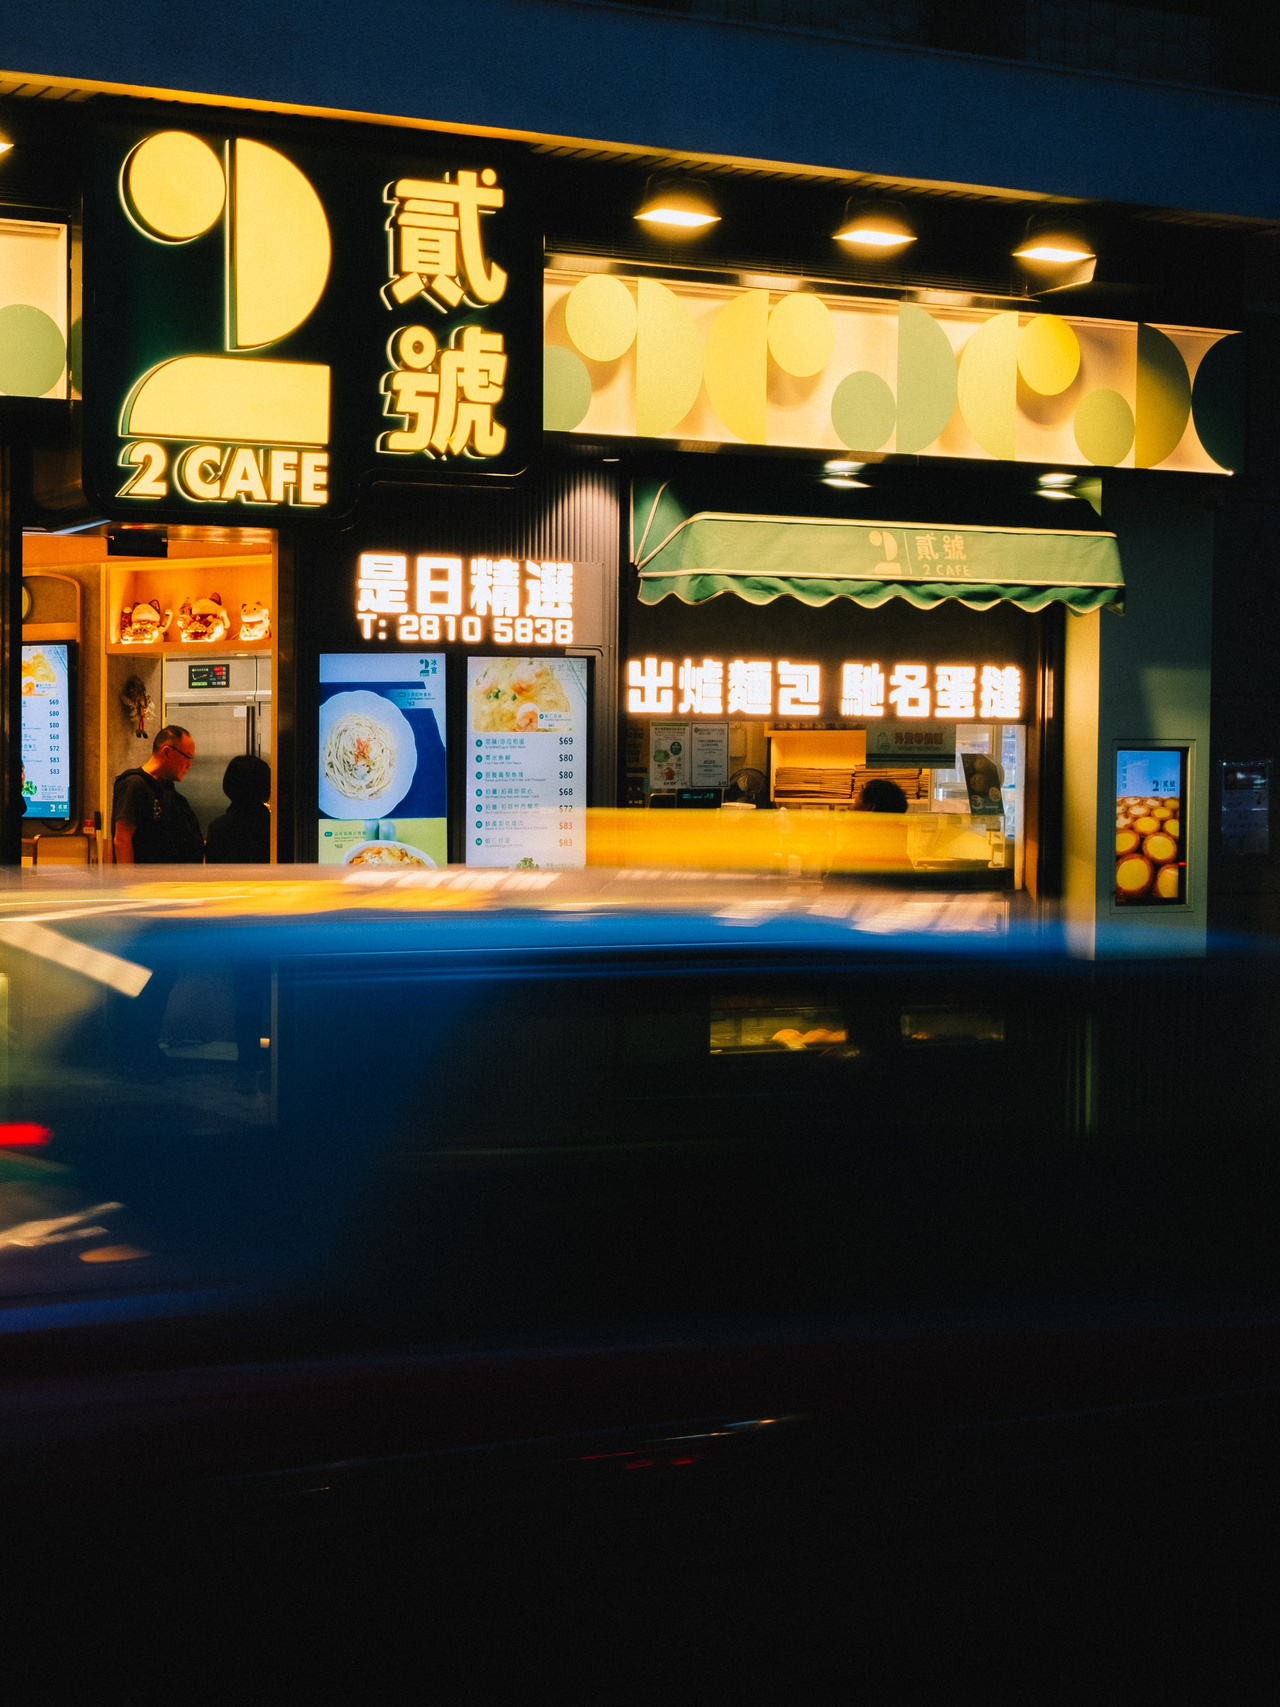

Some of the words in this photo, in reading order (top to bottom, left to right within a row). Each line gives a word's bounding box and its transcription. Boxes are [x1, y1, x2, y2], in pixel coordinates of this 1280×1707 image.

[119, 130, 332, 447] 2
[382, 167, 508, 458] 貳號
[119, 441, 167, 497] 2
[177, 444, 329, 505] CAFE
[915, 531, 967, 561] 貳號
[922, 563, 931, 576] 2
[935, 564, 970, 577] CAFE
[357, 553, 574, 618] 是日精選
[357, 613, 387, 640] T:
[398, 614, 482, 643] 2810
[493, 617, 574, 644] 5838
[627, 657, 821, 715] 出爐麵包
[840, 662, 1021, 719] 馳名蛋撻
[558, 737, 574, 746] $69
[558, 754, 574, 762] $80
[558, 771, 574, 779] $80
[558, 788, 574, 796] $68
[558, 804, 574, 813] $72
[558, 821, 574, 830] $83
[558, 838, 574, 847] $83
